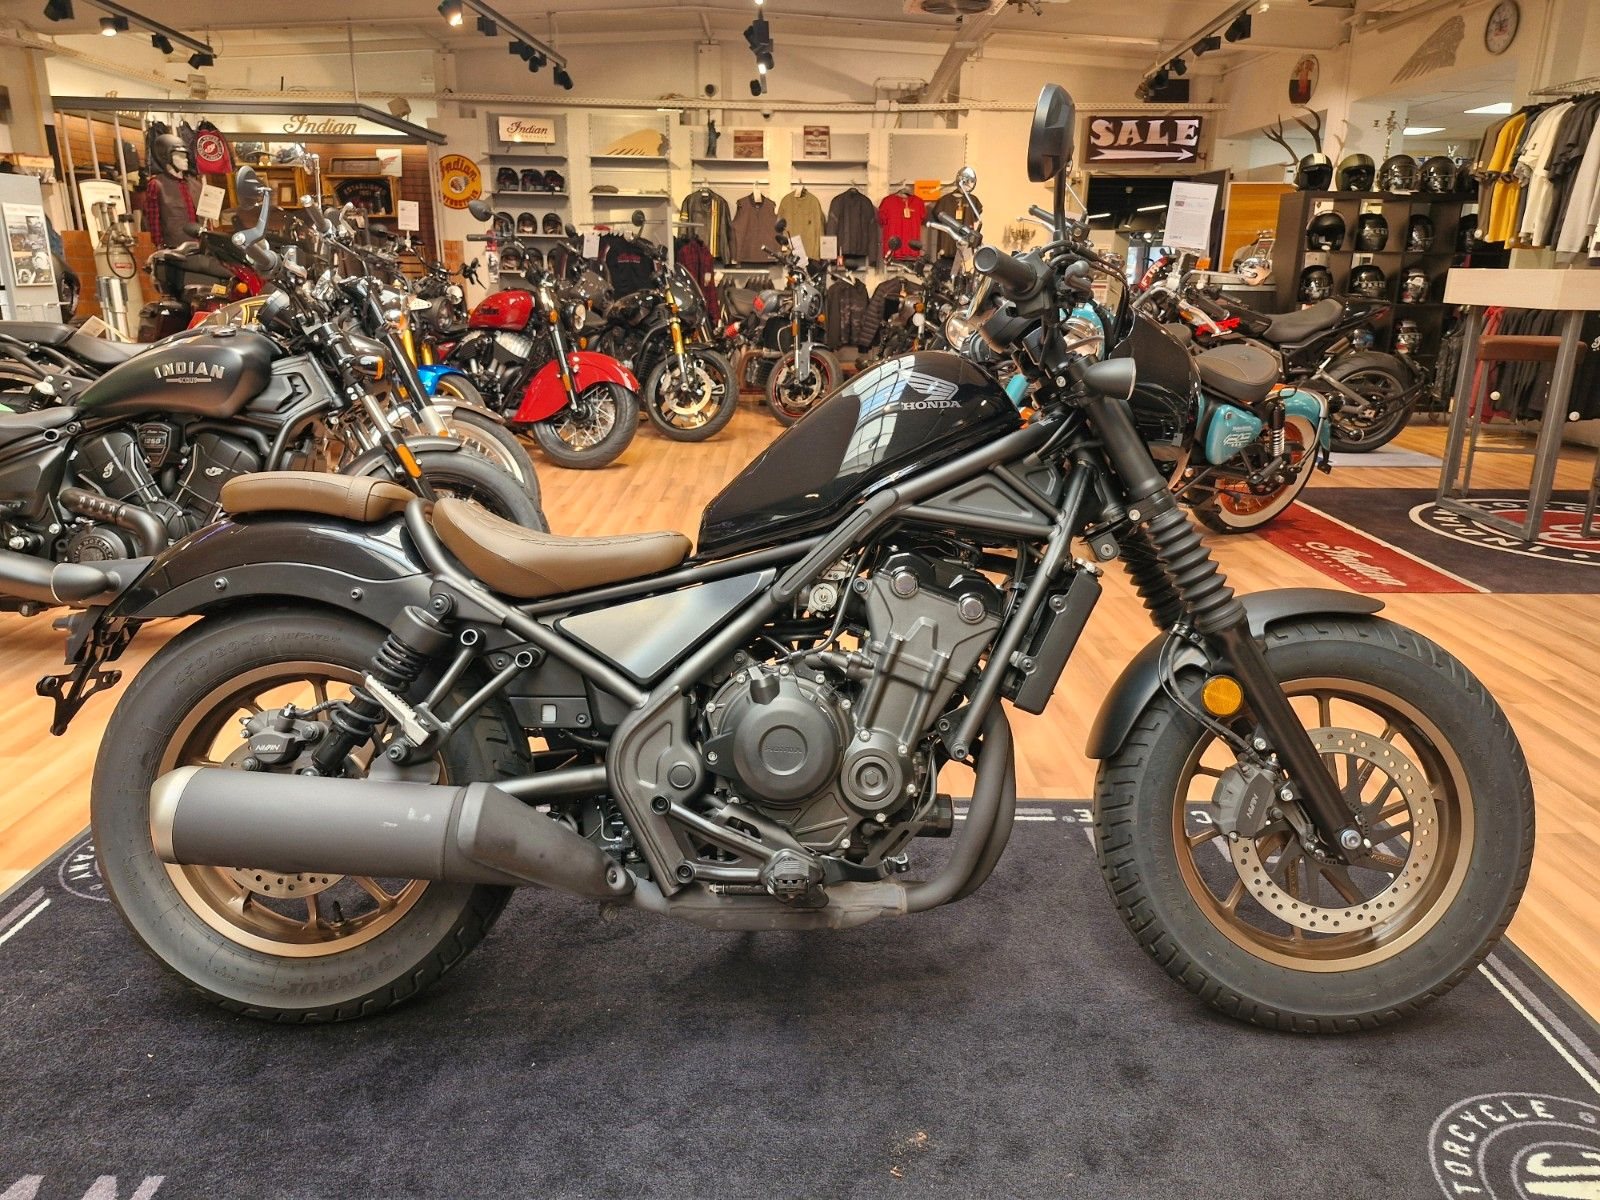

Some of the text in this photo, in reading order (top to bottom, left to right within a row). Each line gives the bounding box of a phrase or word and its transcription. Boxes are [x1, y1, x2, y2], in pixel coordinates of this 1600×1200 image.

[283, 114, 357, 135] Indian
[506, 121, 548, 135] Indian
[1090, 119, 1199, 146] SALE
[154, 361, 225, 379] INDIAN
[902, 400, 962, 411] HONDA
